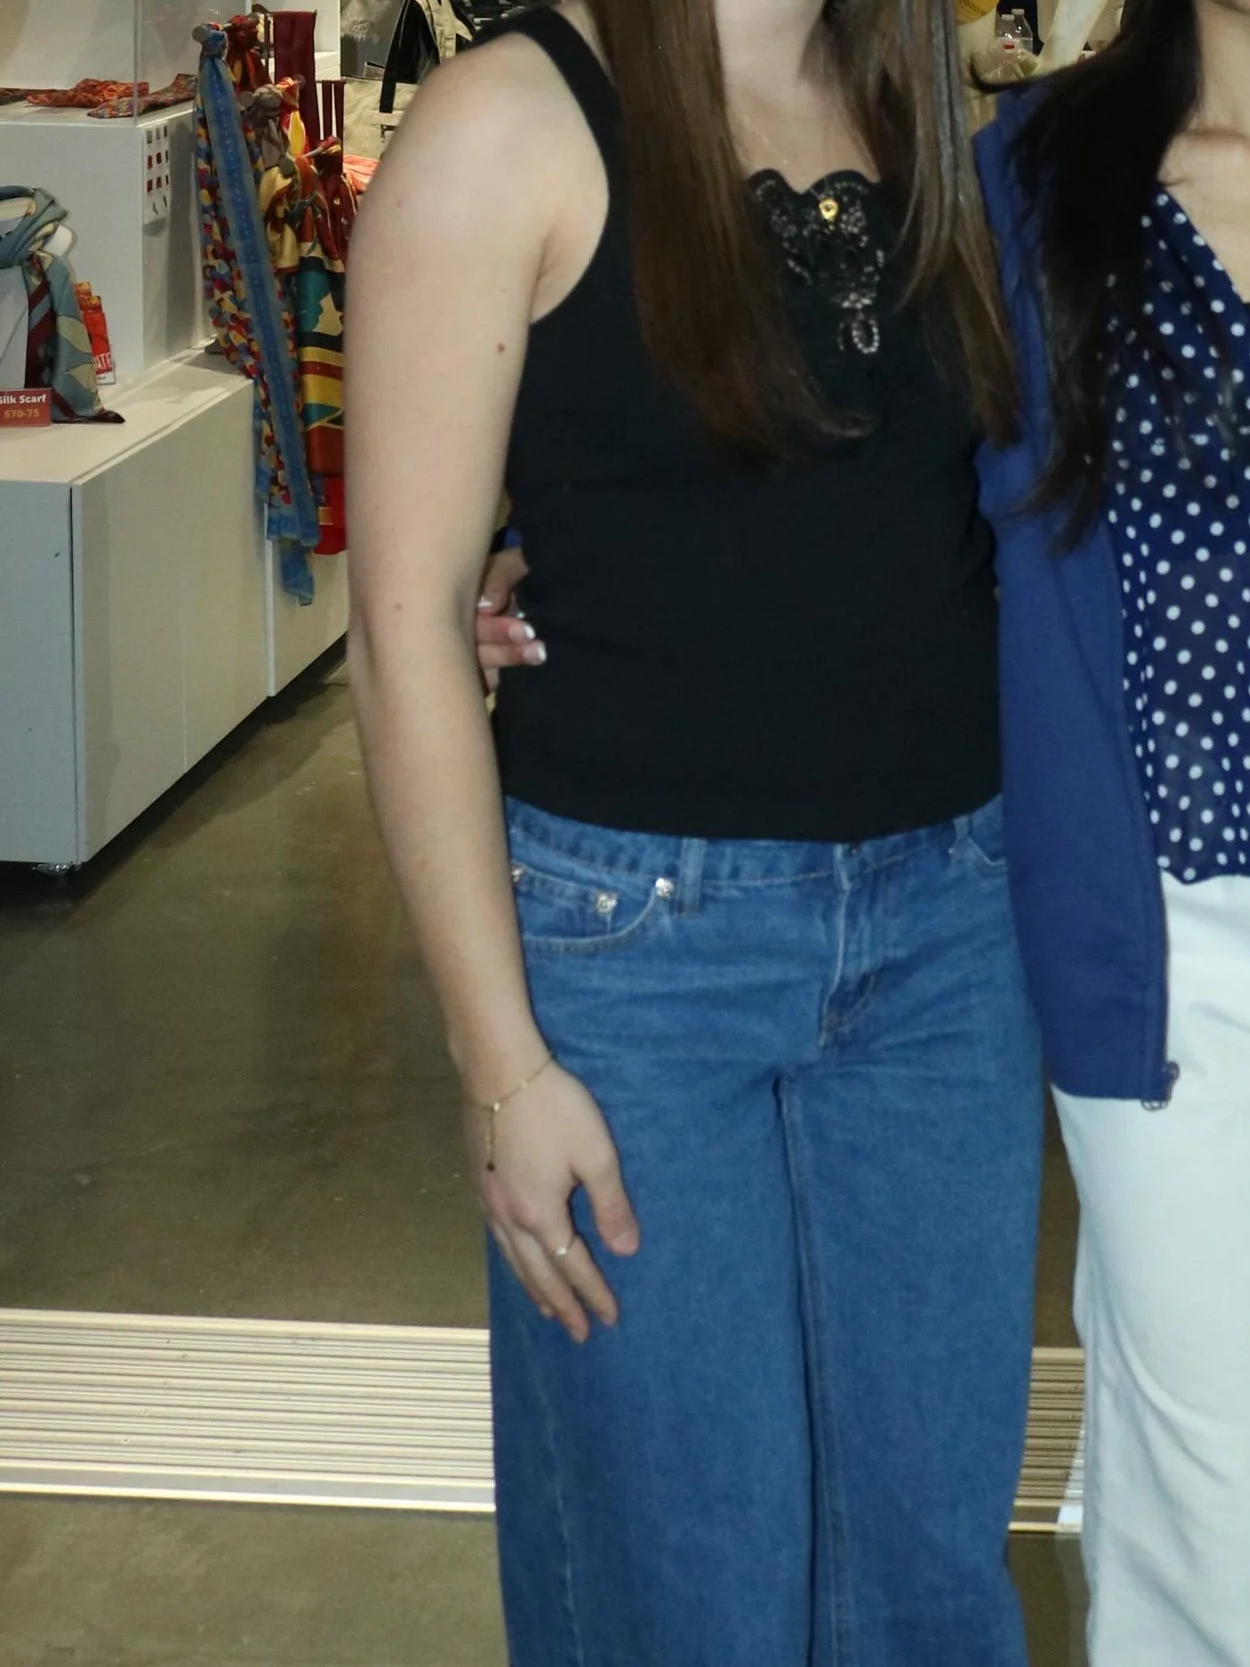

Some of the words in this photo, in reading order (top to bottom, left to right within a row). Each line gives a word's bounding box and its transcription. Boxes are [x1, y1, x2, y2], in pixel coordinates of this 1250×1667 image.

[0, 392, 17, 404] Silk
[19, 394, 47, 404] Scarf
[5, 408, 40, 418] $70-75
